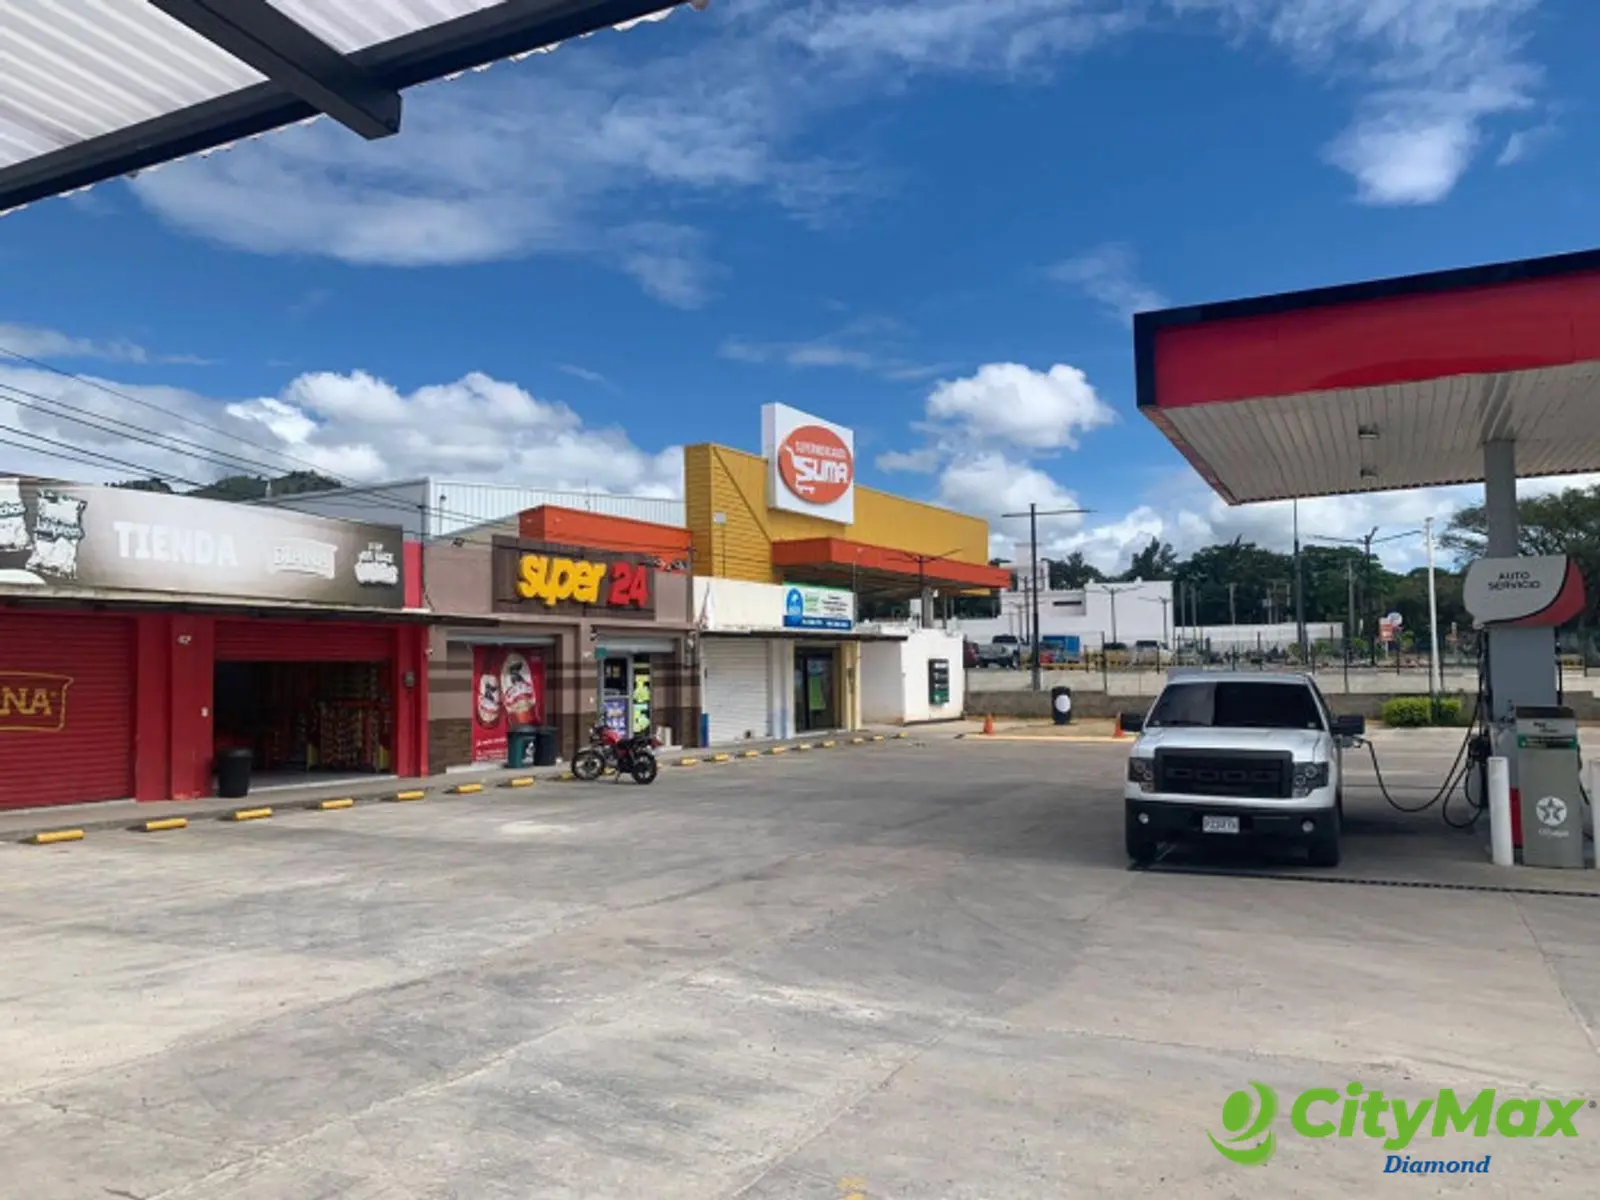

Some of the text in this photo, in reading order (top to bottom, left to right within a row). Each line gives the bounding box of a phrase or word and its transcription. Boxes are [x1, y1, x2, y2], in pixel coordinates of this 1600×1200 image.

[792, 455, 849, 484] SUMA
[113, 520, 239, 567] TIENDA
[609, 561, 648, 608] 24
[1487, 580, 1541, 591] SERVICIO
[1499, 571, 1531, 580] AUTO
